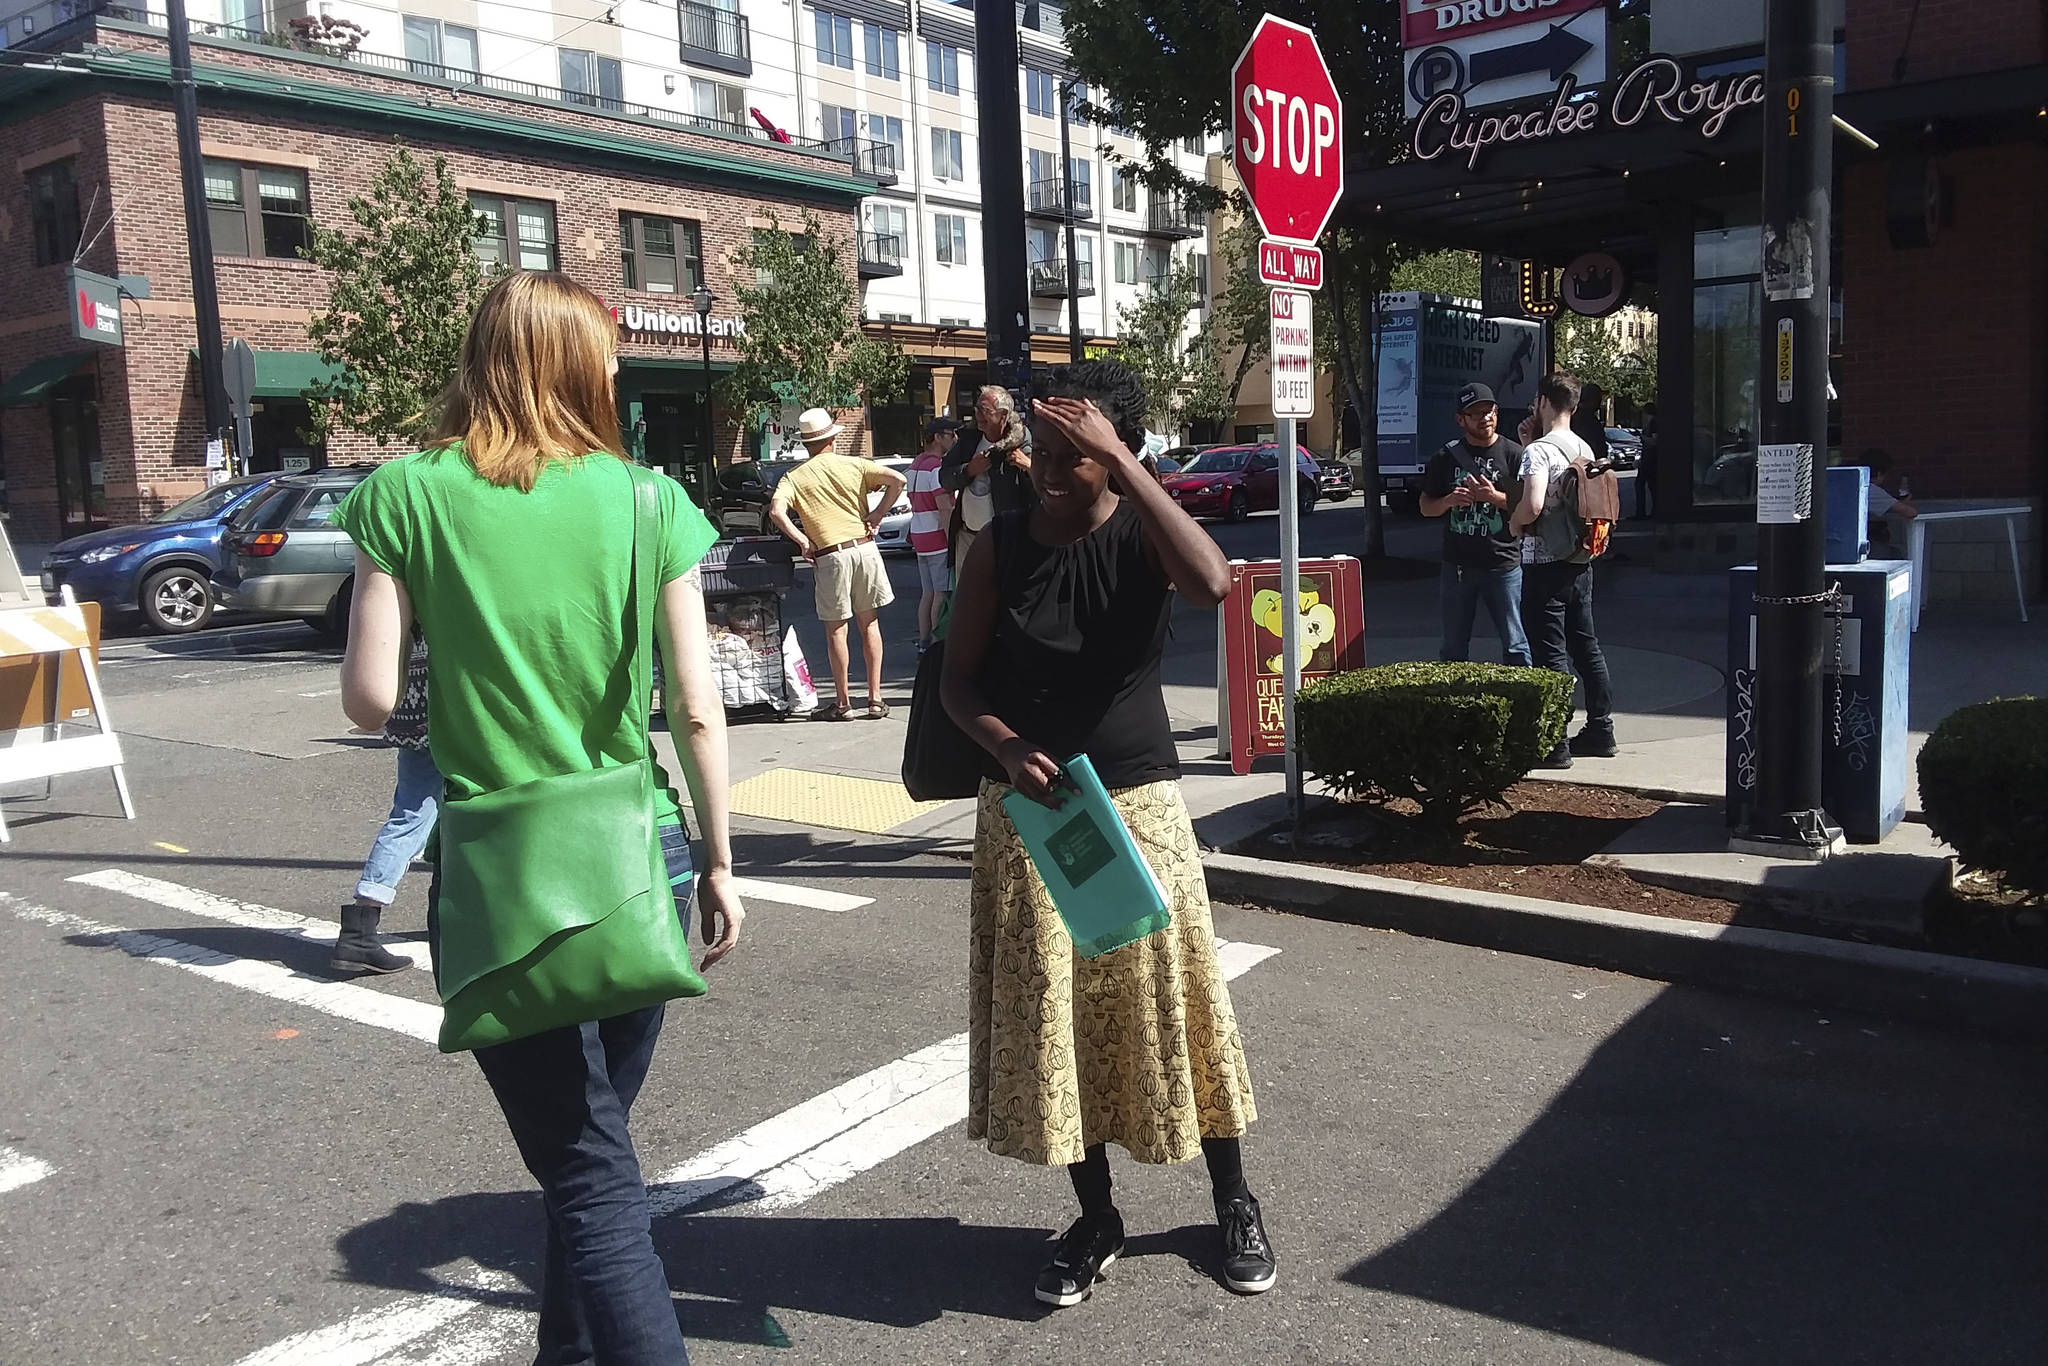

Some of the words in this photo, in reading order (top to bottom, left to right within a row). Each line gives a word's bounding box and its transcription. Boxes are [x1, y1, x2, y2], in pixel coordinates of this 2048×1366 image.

[1423, 58, 1451, 97] P
[1414, 78, 1599, 169] Cupcake
[1612, 59, 1765, 137] Roya
[1242, 84, 1335, 177] STOP
[1265, 249, 1287, 275] ALL
[1293, 254, 1317, 280] WAY
[96, 301, 119, 319] Union
[1274, 293, 1291, 317] NO
[97, 316, 116, 333] Bank
[1276, 326, 1309, 347] PARKING
[1424, 309, 1459, 340] HIGH
[1463, 317, 1500, 344] SPEED
[1278, 353, 1307, 373] WITHIN
[1423, 342, 1484, 371] INTERNET
[1277, 380, 1287, 399] 30
[1290, 381, 1308, 399] FEET
[1257, 678, 1284, 697] QUE
